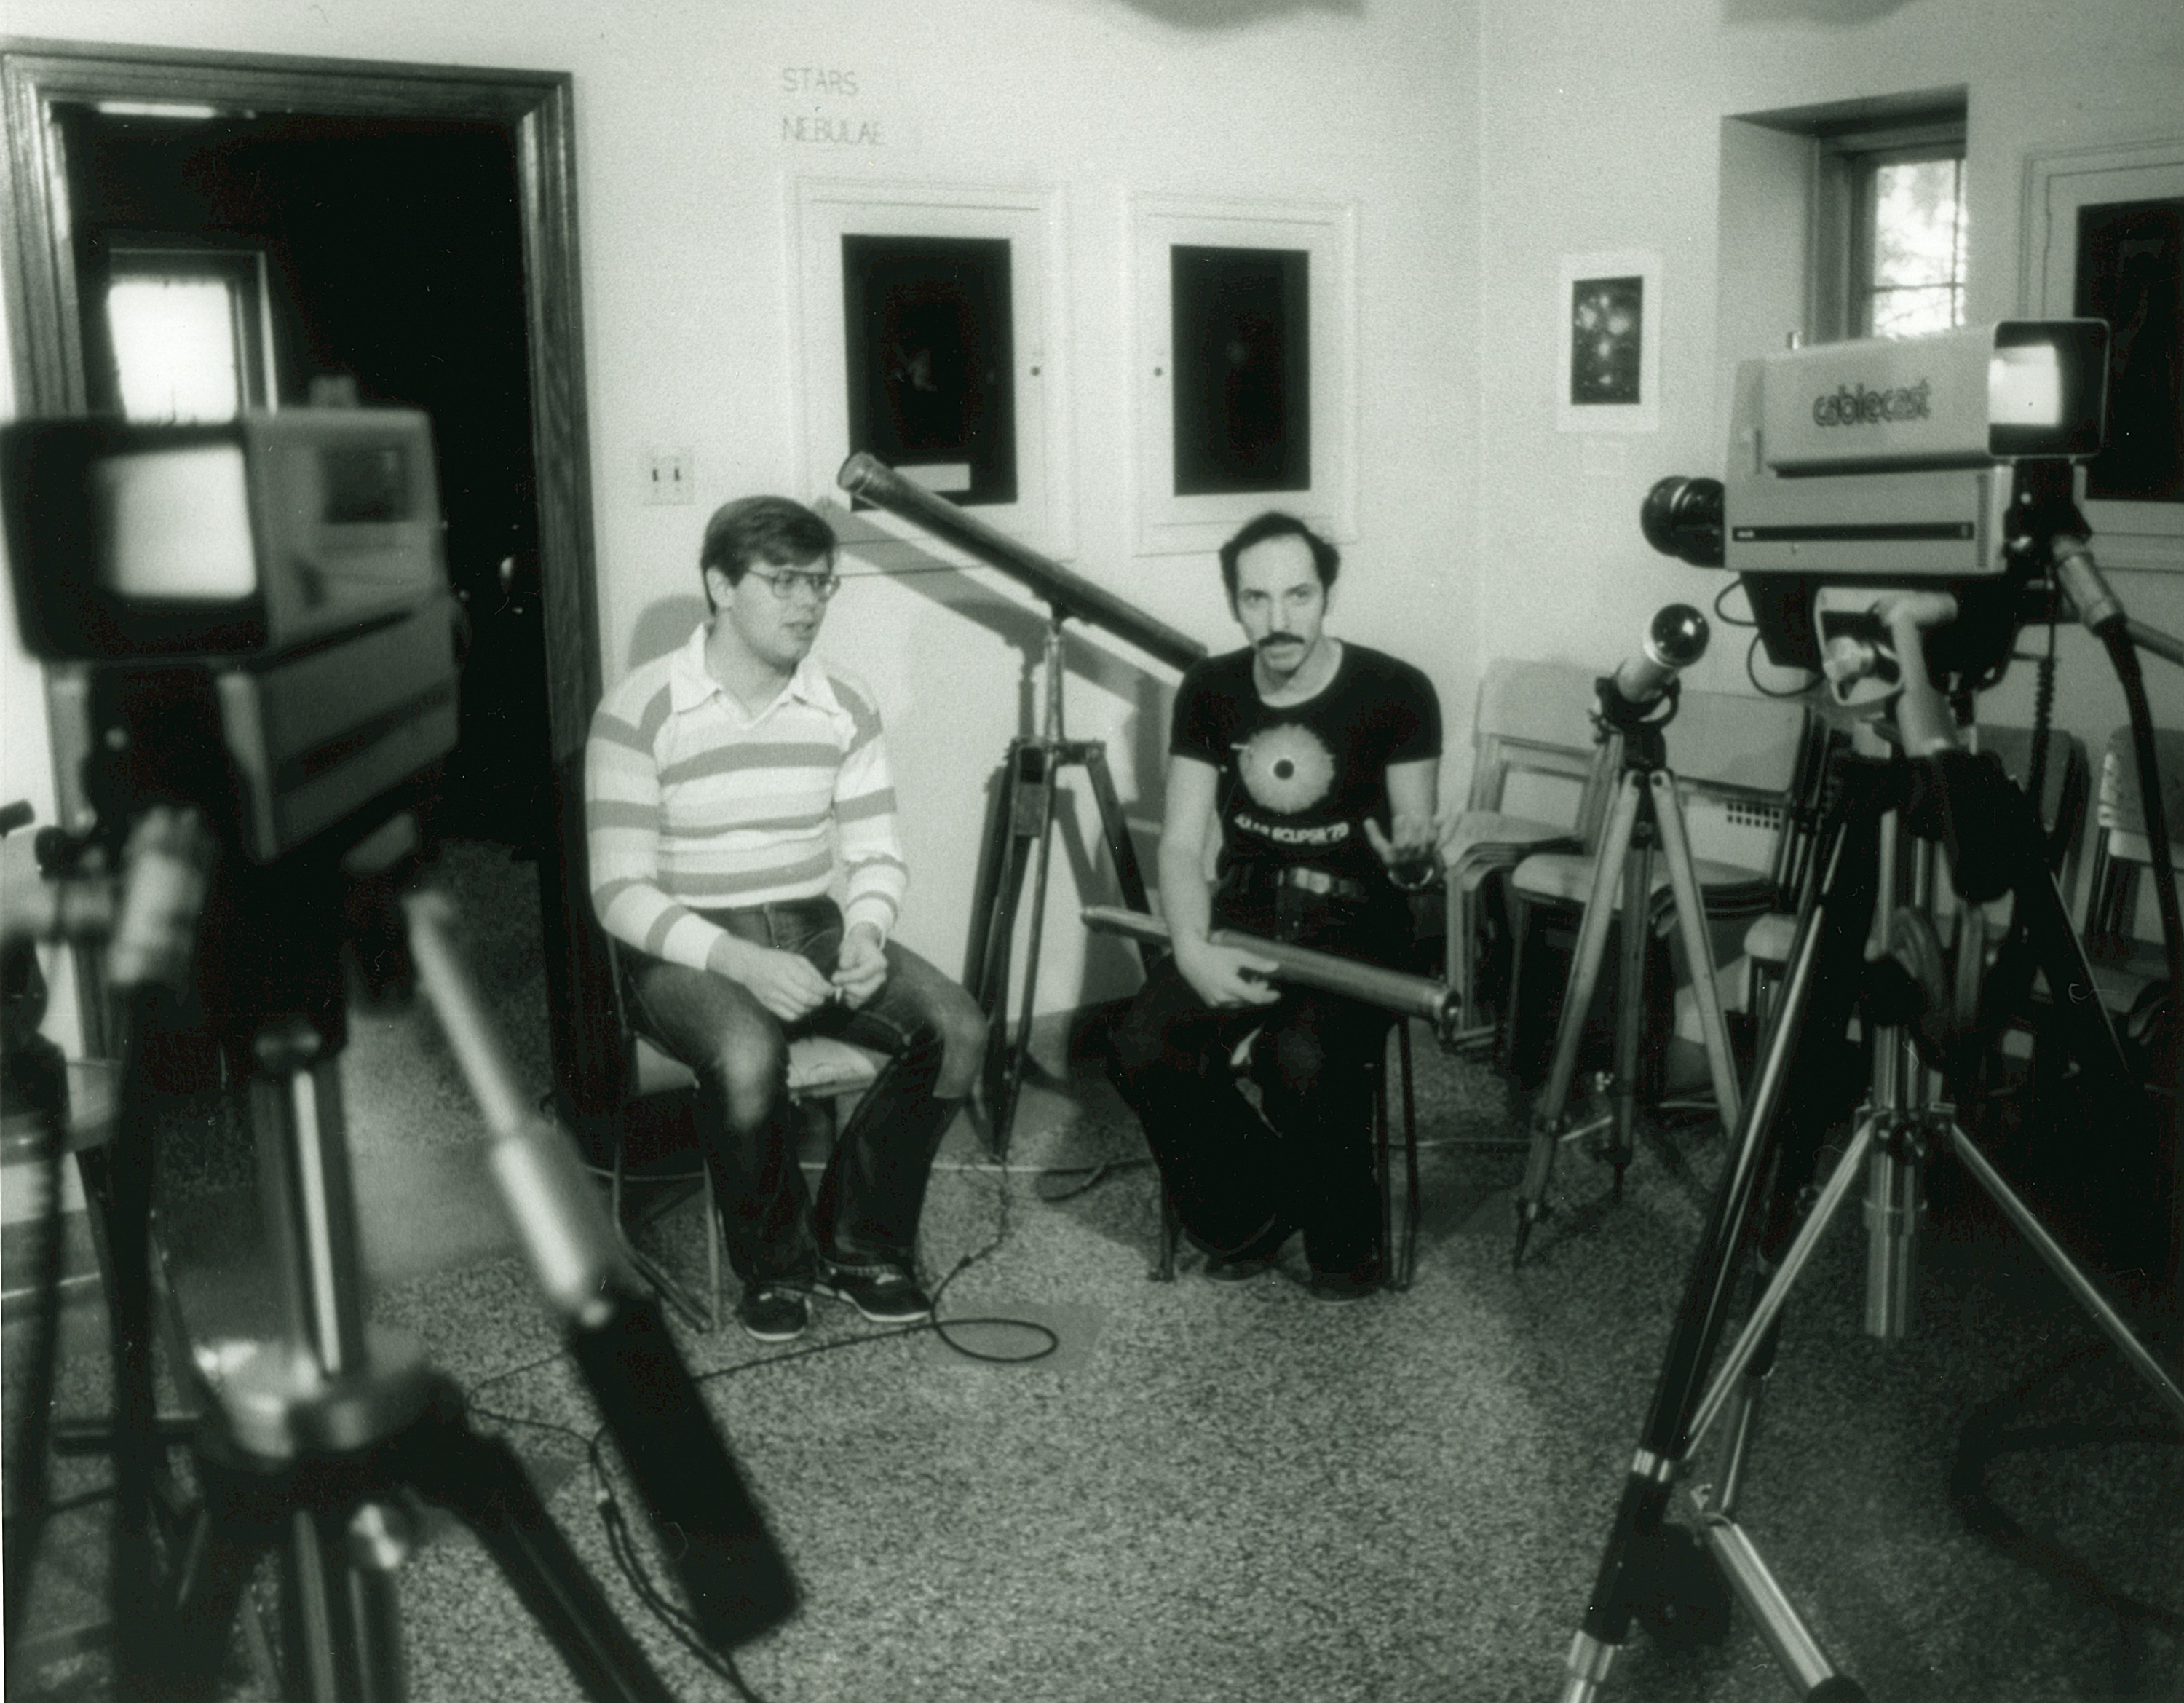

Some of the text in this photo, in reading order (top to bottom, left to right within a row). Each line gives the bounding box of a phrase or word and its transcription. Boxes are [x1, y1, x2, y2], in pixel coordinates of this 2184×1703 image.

[782, 66, 858, 96] STARS
[782, 116, 887, 145] NEBULAE
[1813, 378, 1931, 427] cablecast
